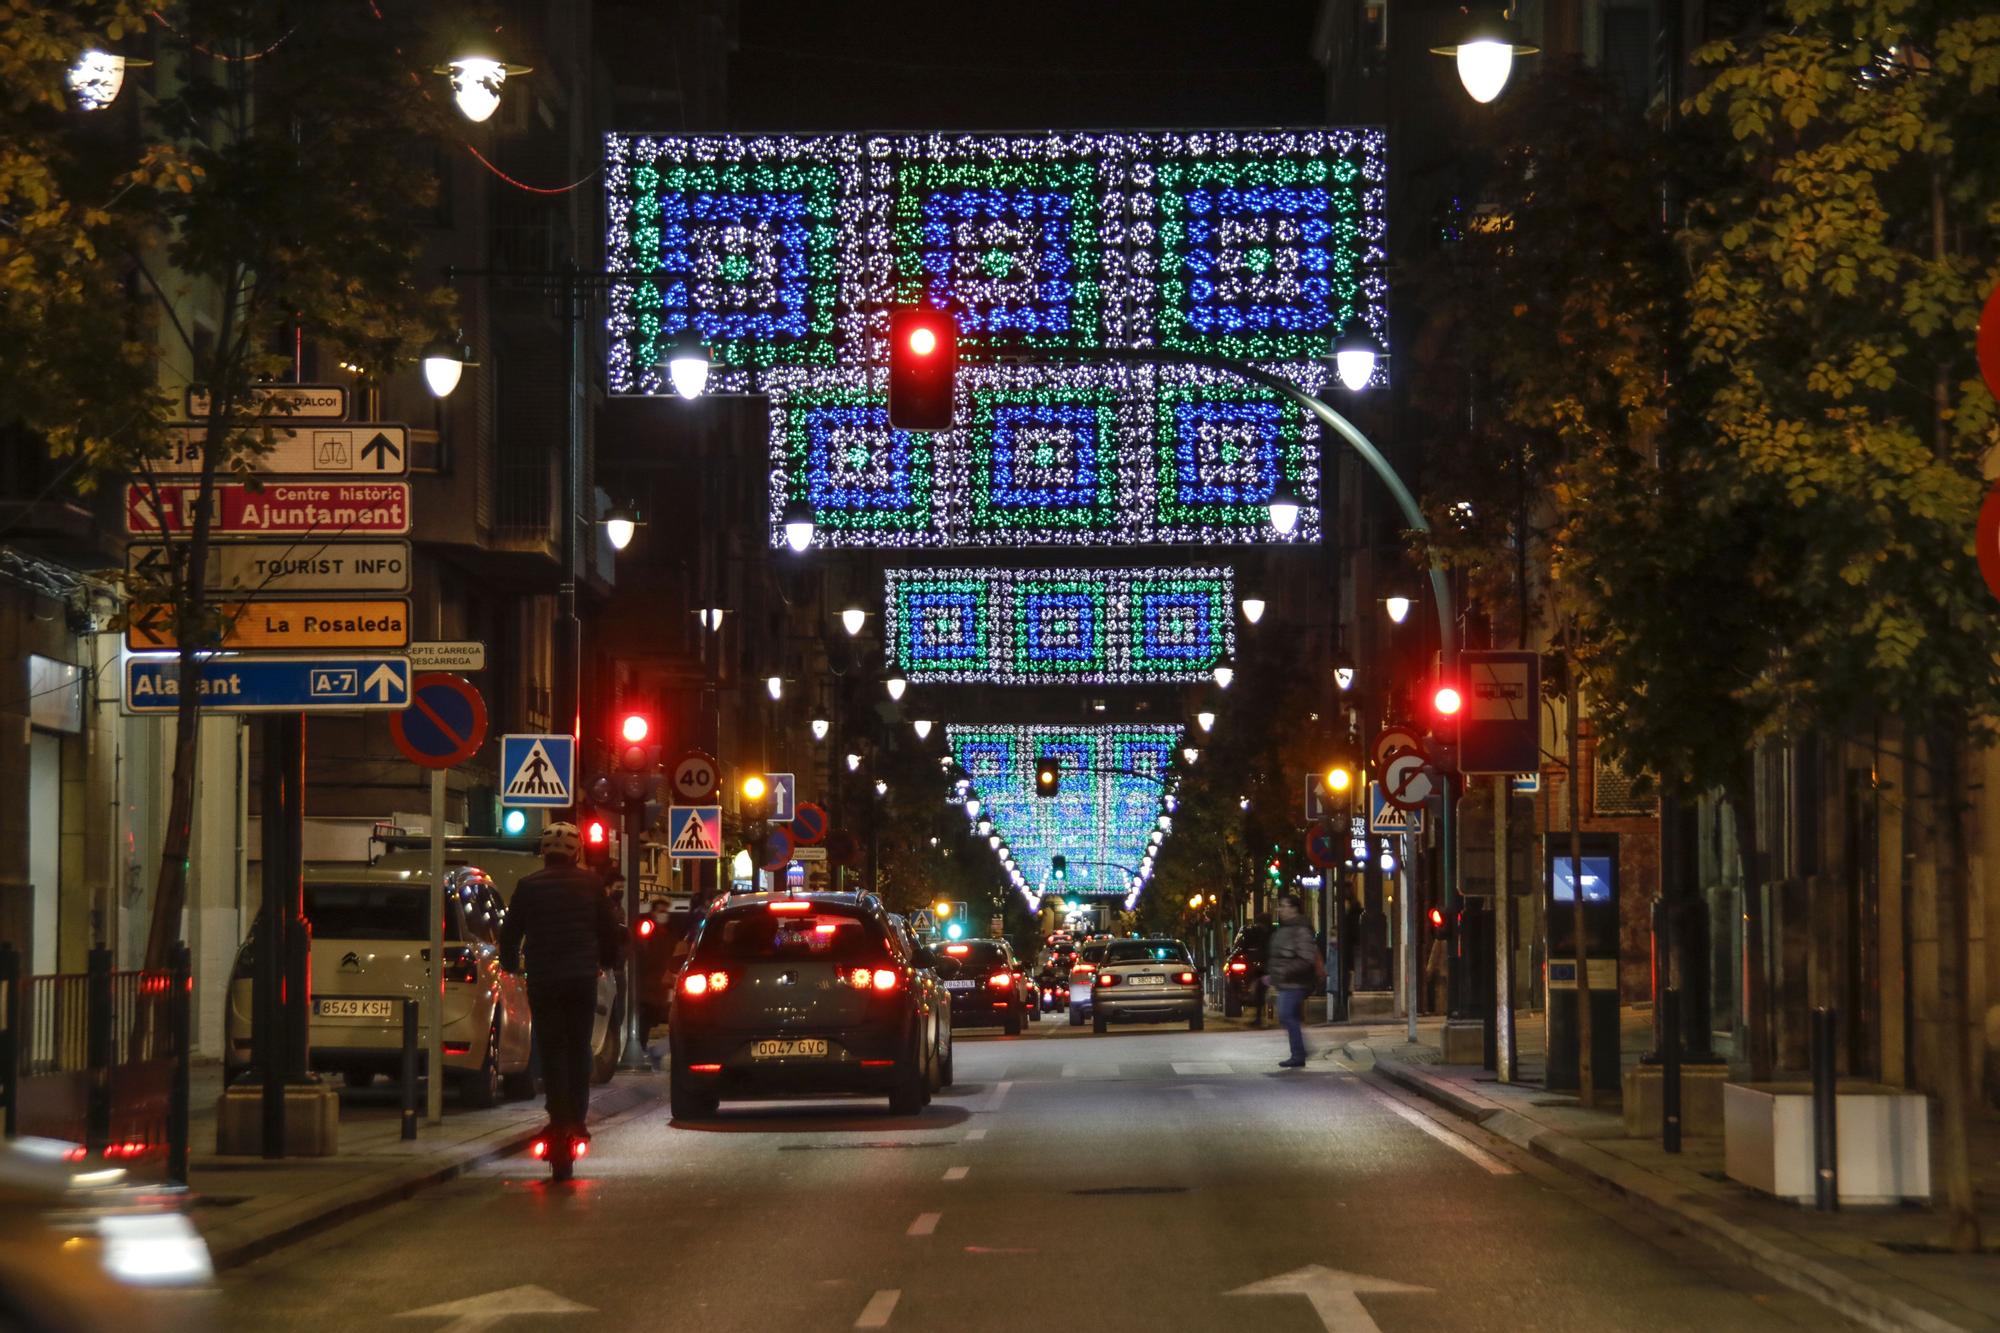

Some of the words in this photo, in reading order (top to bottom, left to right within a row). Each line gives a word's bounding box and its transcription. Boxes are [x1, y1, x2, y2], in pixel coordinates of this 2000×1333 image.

[294, 398, 337, 407] D'ALCOI
[275, 488, 330, 501] Centre
[339, 486, 401, 501] històric
[241, 503, 402, 528] Ajuntament
[255, 559, 344, 575] TOURIST
[354, 559, 402, 574] INFO
[265, 616, 290, 633] La
[304, 615, 402, 633] Rosaleda
[135, 672, 242, 696] Alaant
[315, 674, 353, 691] A-7
[680, 768, 710, 787] 40
[322, 1001, 358, 1014] 8549
[361, 1002, 389, 1014] KSH
[759, 1041, 793, 1055] 0047
[797, 1041, 825, 1054] GVC
